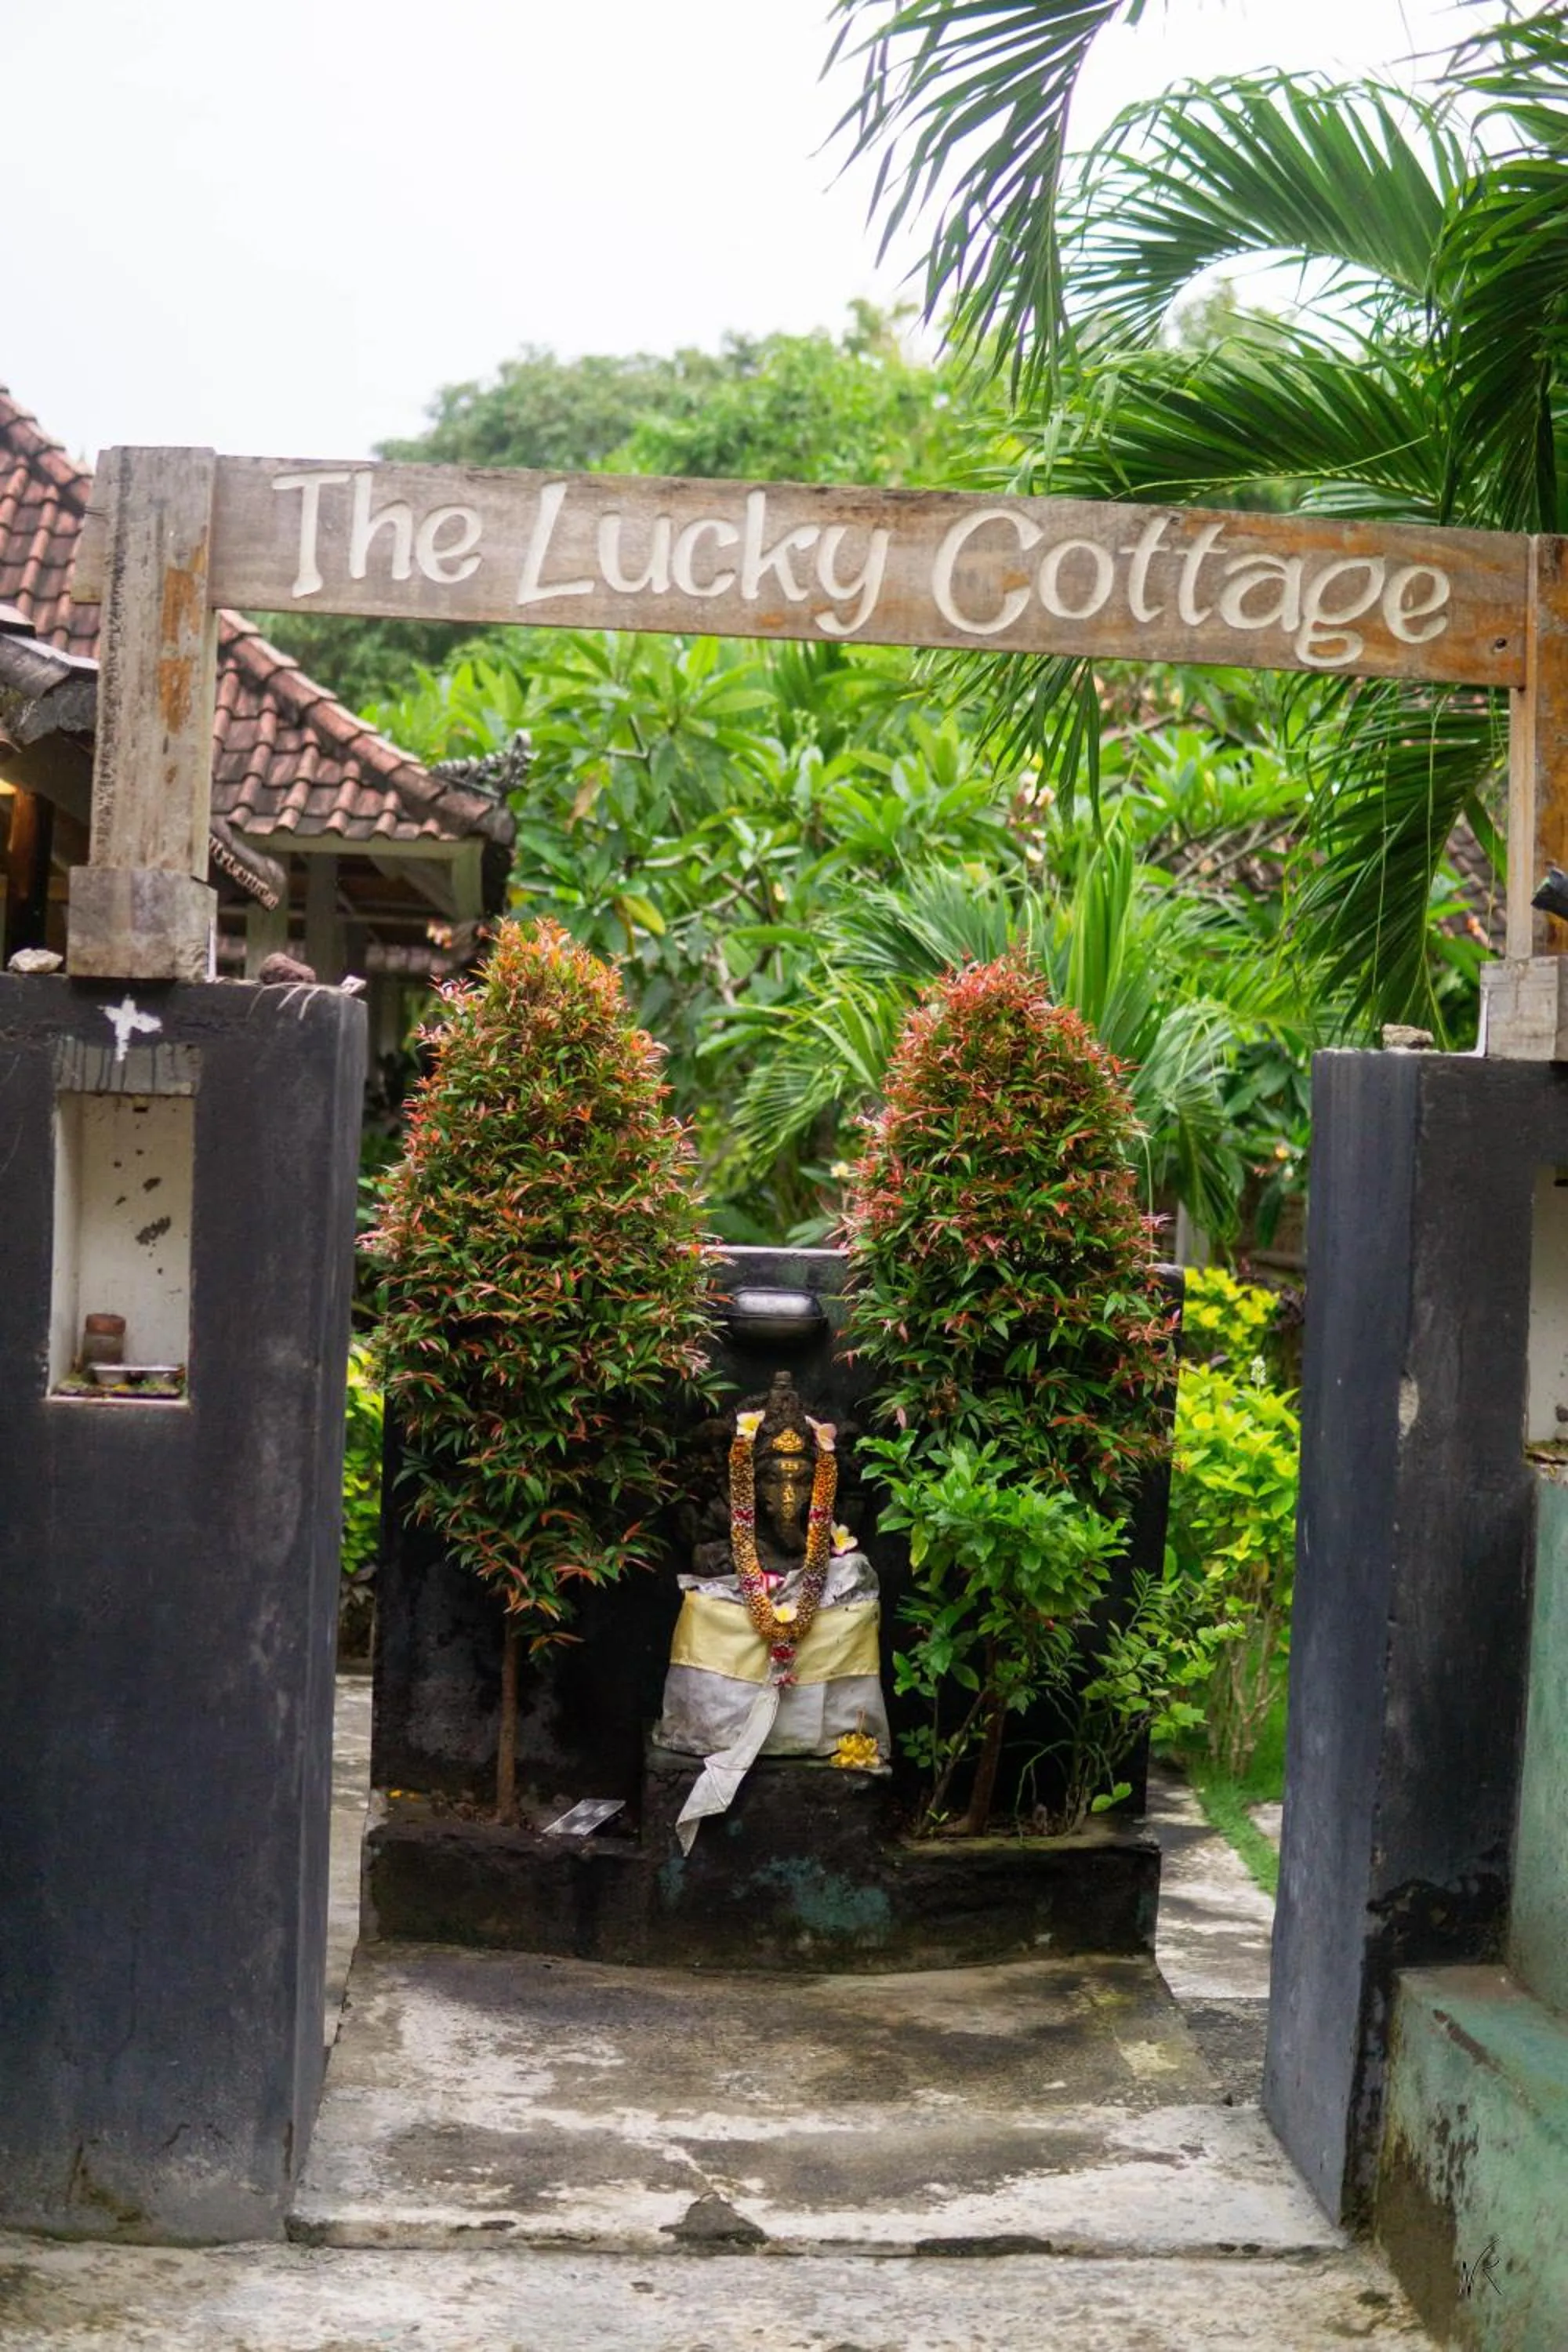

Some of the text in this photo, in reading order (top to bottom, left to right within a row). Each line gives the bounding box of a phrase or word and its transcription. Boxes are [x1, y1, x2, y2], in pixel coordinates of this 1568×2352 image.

[271, 471, 1451, 667] The Lucky Cottage
